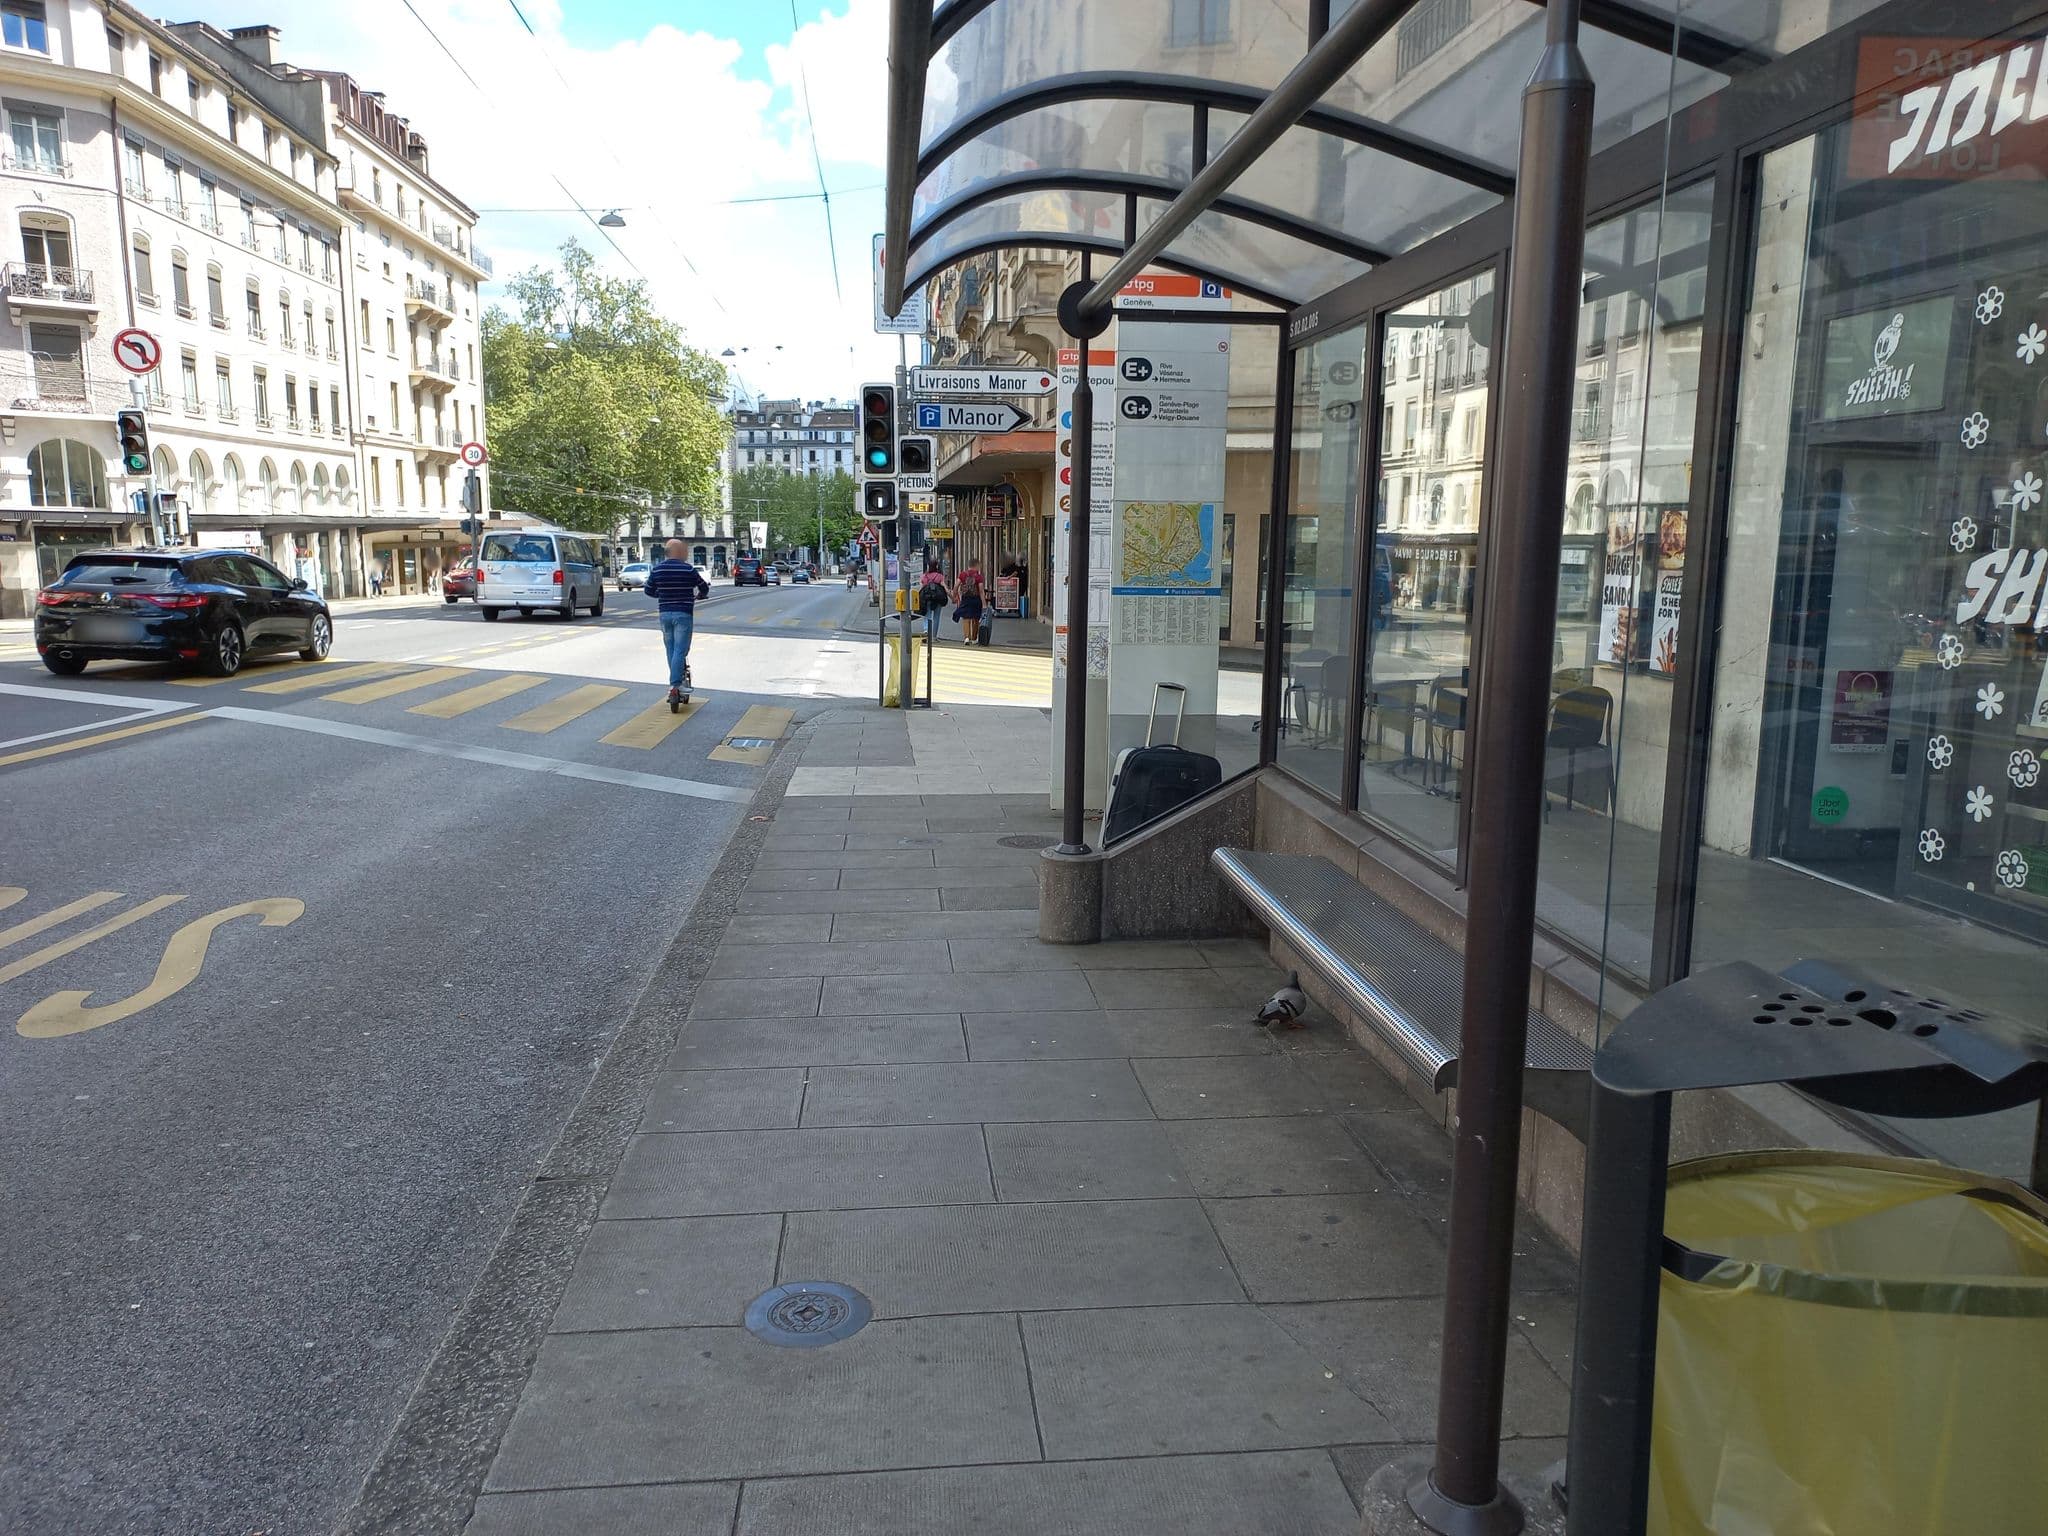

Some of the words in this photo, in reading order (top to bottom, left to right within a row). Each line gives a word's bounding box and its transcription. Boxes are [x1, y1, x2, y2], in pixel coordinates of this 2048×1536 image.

[918, 374, 980, 389] Livraisons
[989, 374, 1028, 390] Manor
[948, 407, 1005, 426] Manor
[468, 449, 479, 459] 30
